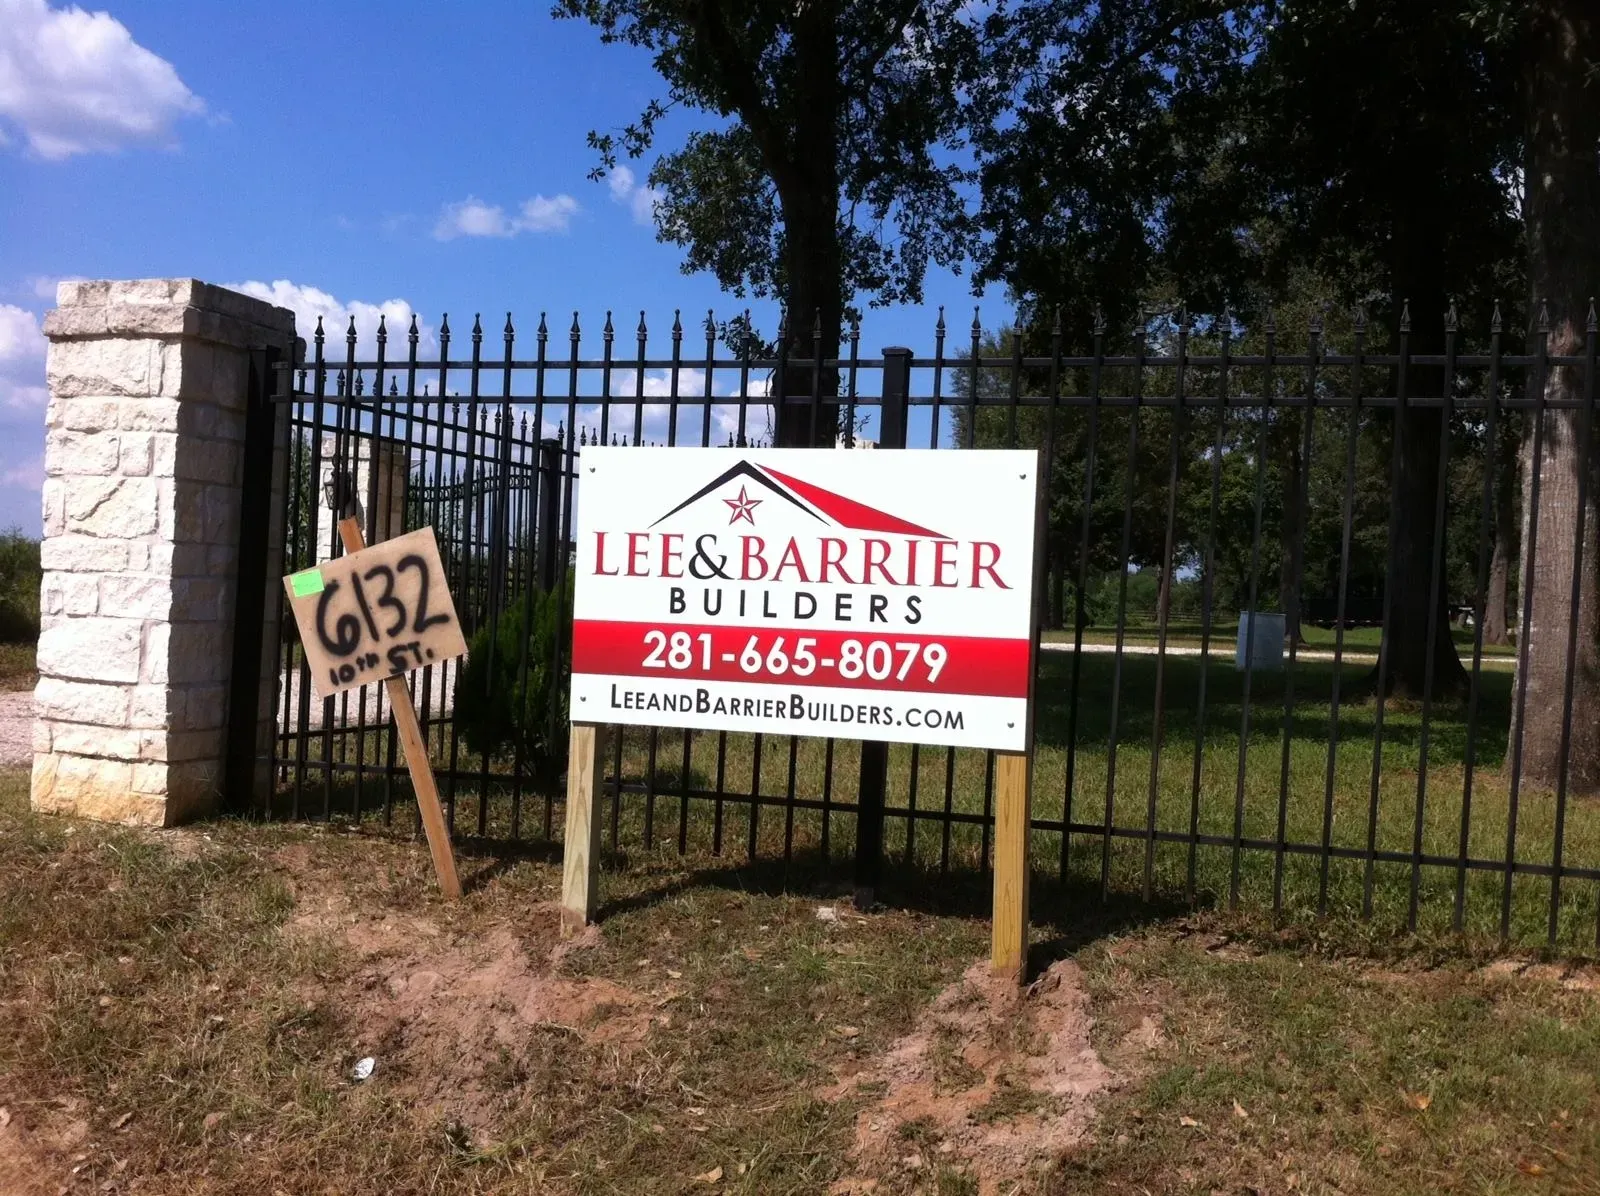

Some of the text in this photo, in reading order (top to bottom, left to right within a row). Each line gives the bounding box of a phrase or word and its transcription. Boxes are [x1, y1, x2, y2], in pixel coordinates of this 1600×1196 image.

[316, 554, 450, 657] 6132
[669, 587, 923, 624] BUILDERS
[387, 641, 434, 674] ST.
[642, 630, 948, 683] 281-665-8079
